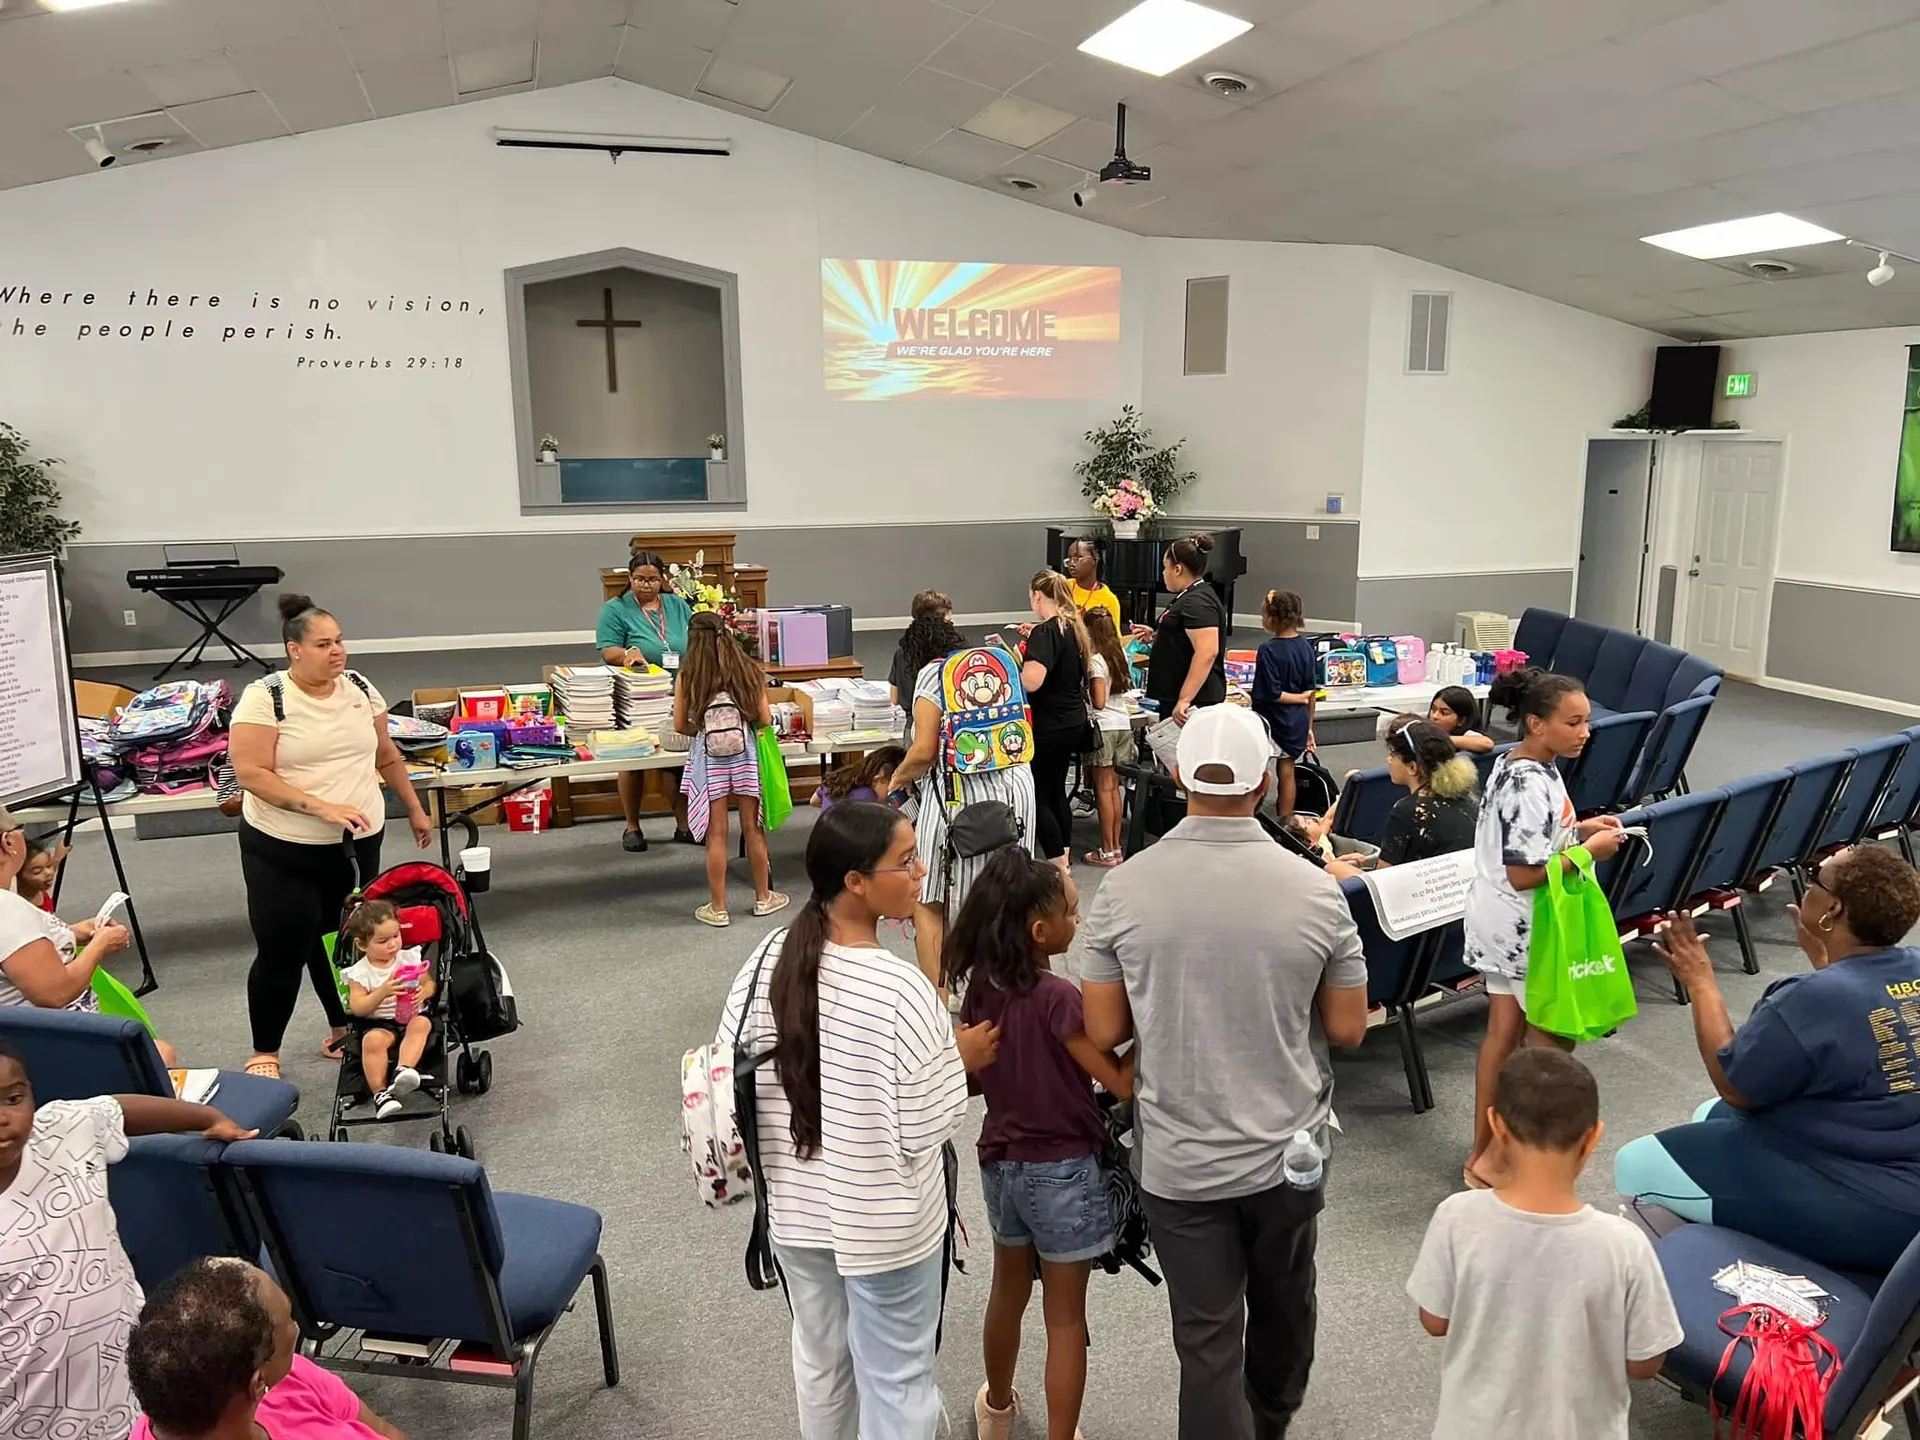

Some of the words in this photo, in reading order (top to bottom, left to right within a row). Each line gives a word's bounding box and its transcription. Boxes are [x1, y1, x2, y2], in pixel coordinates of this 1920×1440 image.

[0, 286, 97, 305] Where
[128, 289, 221, 308] there
[251, 291, 282, 309] is
[308, 298, 340, 311] no
[367, 294, 486, 315] vision,
[0, 317, 48, 336] he
[77, 319, 195, 342] people
[221, 322, 343, 343] perish.
[893, 307, 1058, 340] WELCOME
[296, 356, 393, 369] Proverbs
[406, 356, 464, 369] 29:18
[897, 345, 937, 356] WE'RE
[939, 346, 972, 356] GLAD
[974, 346, 1020, 357] YOU'RE
[1020, 346, 1054, 357] HERE
[1726, 374, 1752, 396] EXIT
